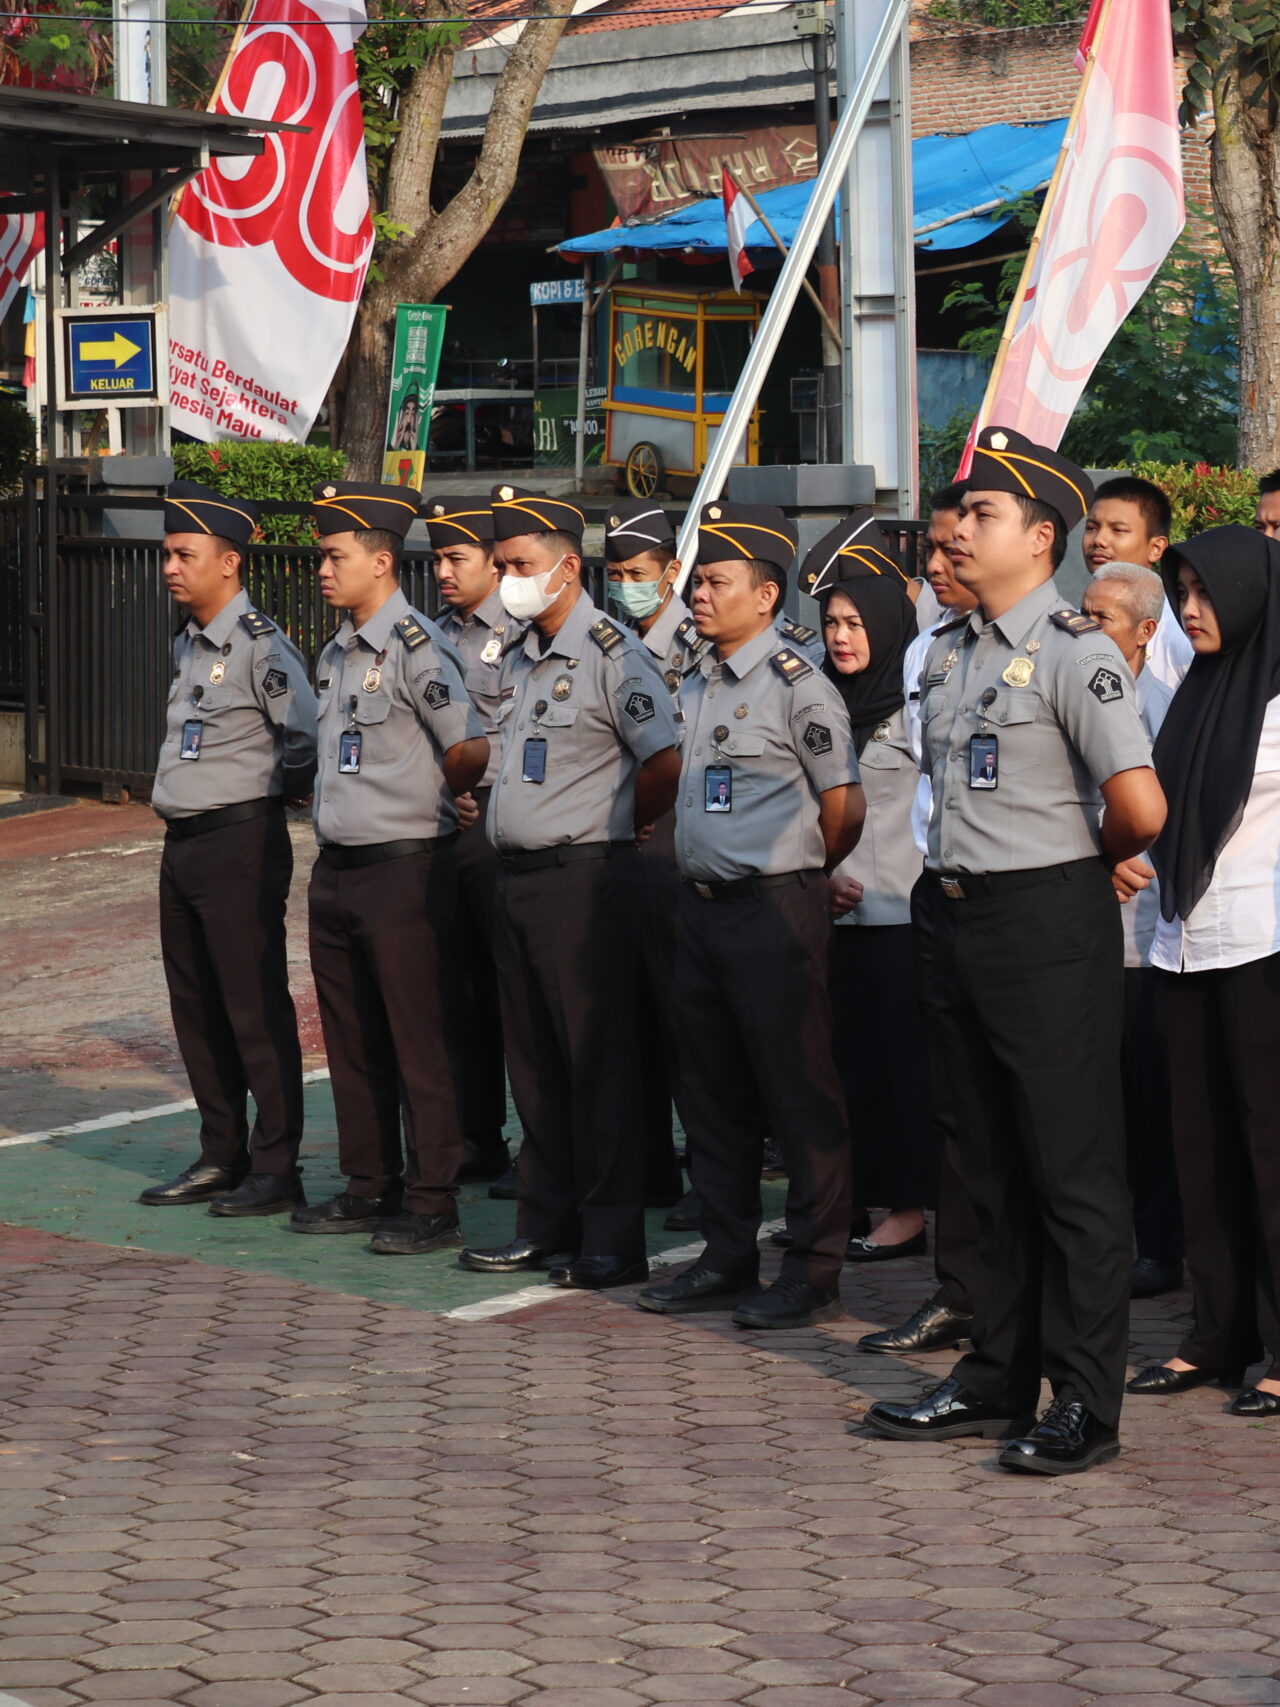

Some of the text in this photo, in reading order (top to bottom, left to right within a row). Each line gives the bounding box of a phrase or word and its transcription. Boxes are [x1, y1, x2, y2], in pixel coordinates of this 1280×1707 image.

[533, 281, 561, 300] KOPI
[563, 281, 573, 298] &
[614, 320, 697, 373] GORENGAN
[90, 378, 135, 390] KELUAR
[200, 378, 289, 425] Sejahtera
[211, 359, 298, 415] Berdaulat
[169, 388, 262, 438] nesia Maju
